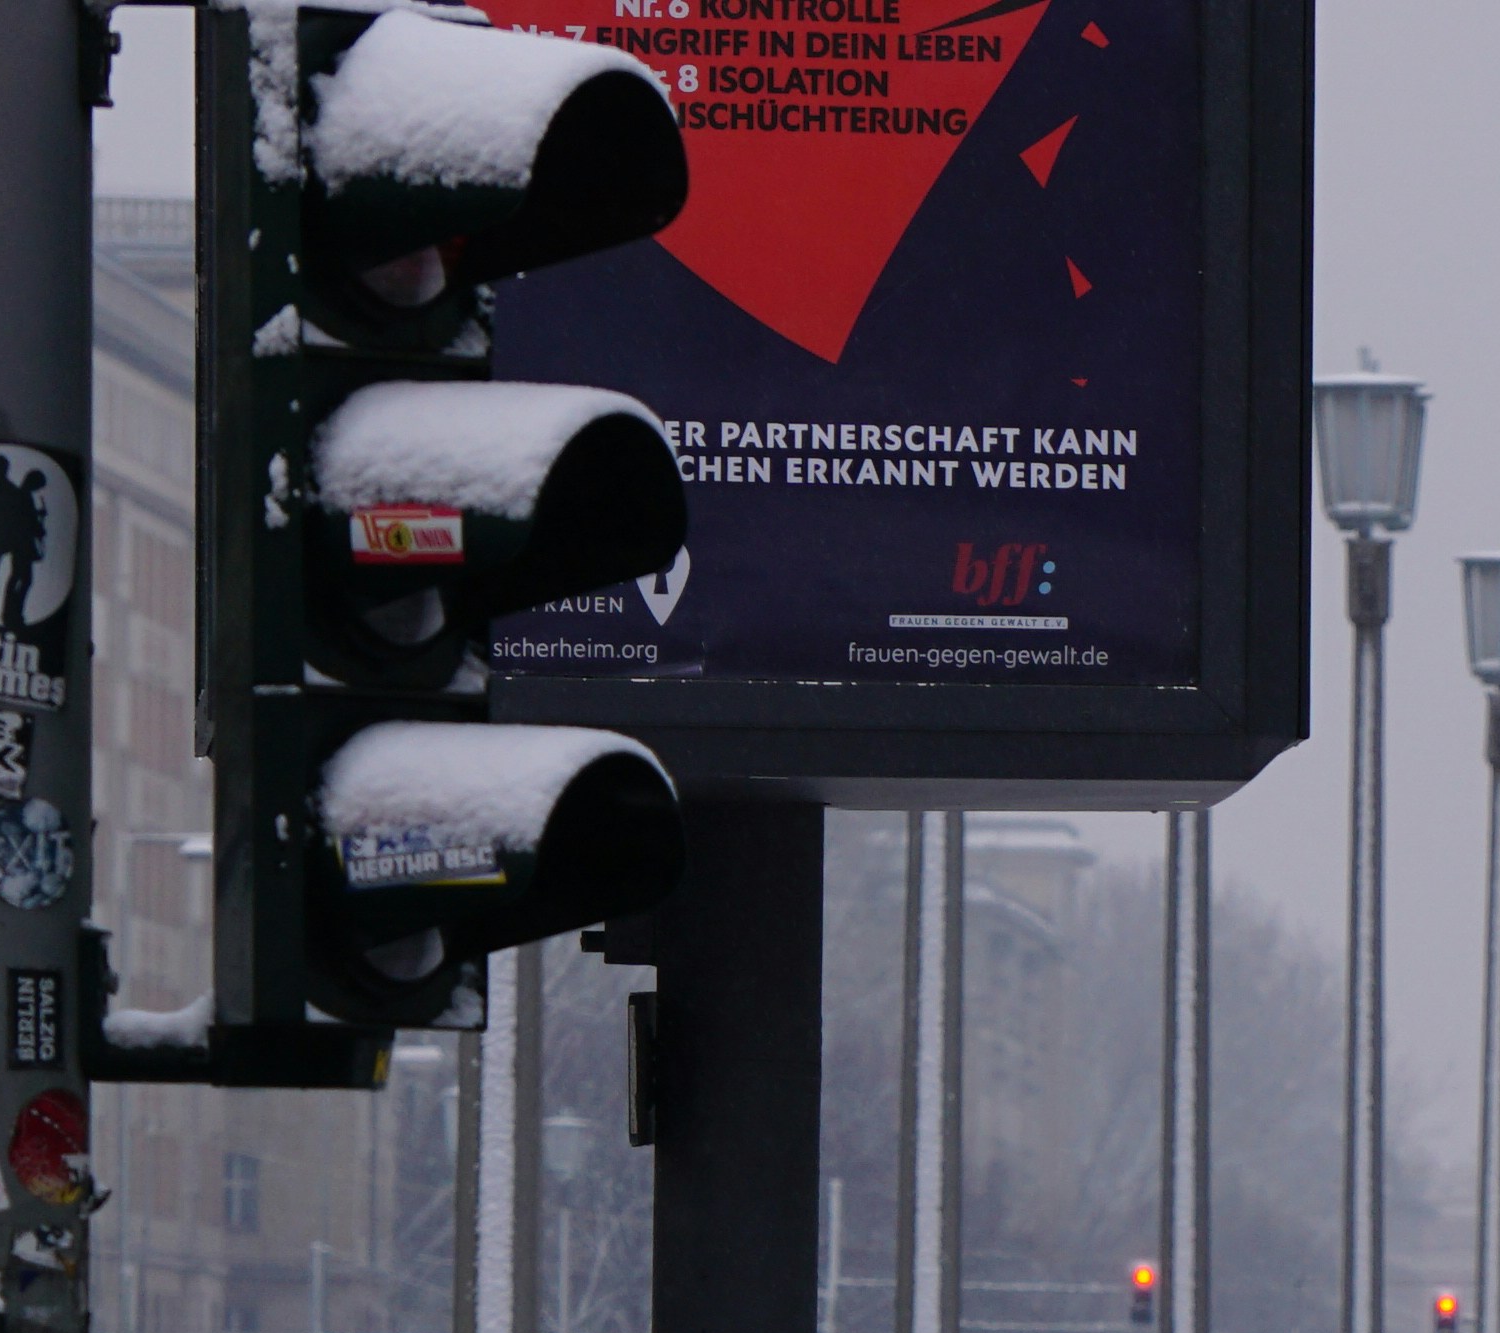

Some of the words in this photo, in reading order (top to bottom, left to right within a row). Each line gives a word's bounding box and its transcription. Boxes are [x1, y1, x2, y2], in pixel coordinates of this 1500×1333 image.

[759, 31, 795, 58] IN
[803, 31, 887, 60] DEIN
[899, 33, 1001, 62] LEBEN
[678, 65, 698, 92] 8
[707, 66, 888, 98] ISOLATION
[720, 422, 1020, 454] PARTNERSCHAFT
[1034, 429, 1137, 456] KANN
[786, 458, 958, 487] ERKANNT
[971, 461, 1126, 490] WERDEN
[892, 616, 938, 626] FRAUEN
[945, 617, 985, 627] GEGEN
[991, 618, 1037, 628] GEWALT
[493, 637, 658, 663] sicherheim.org
[849, 641, 1108, 668] frauen-gegen-gewalt.de
[348, 850, 441, 883] HERTHA
[444, 845, 496, 871] BSC
[17, 977, 35, 1061] BERLIN
